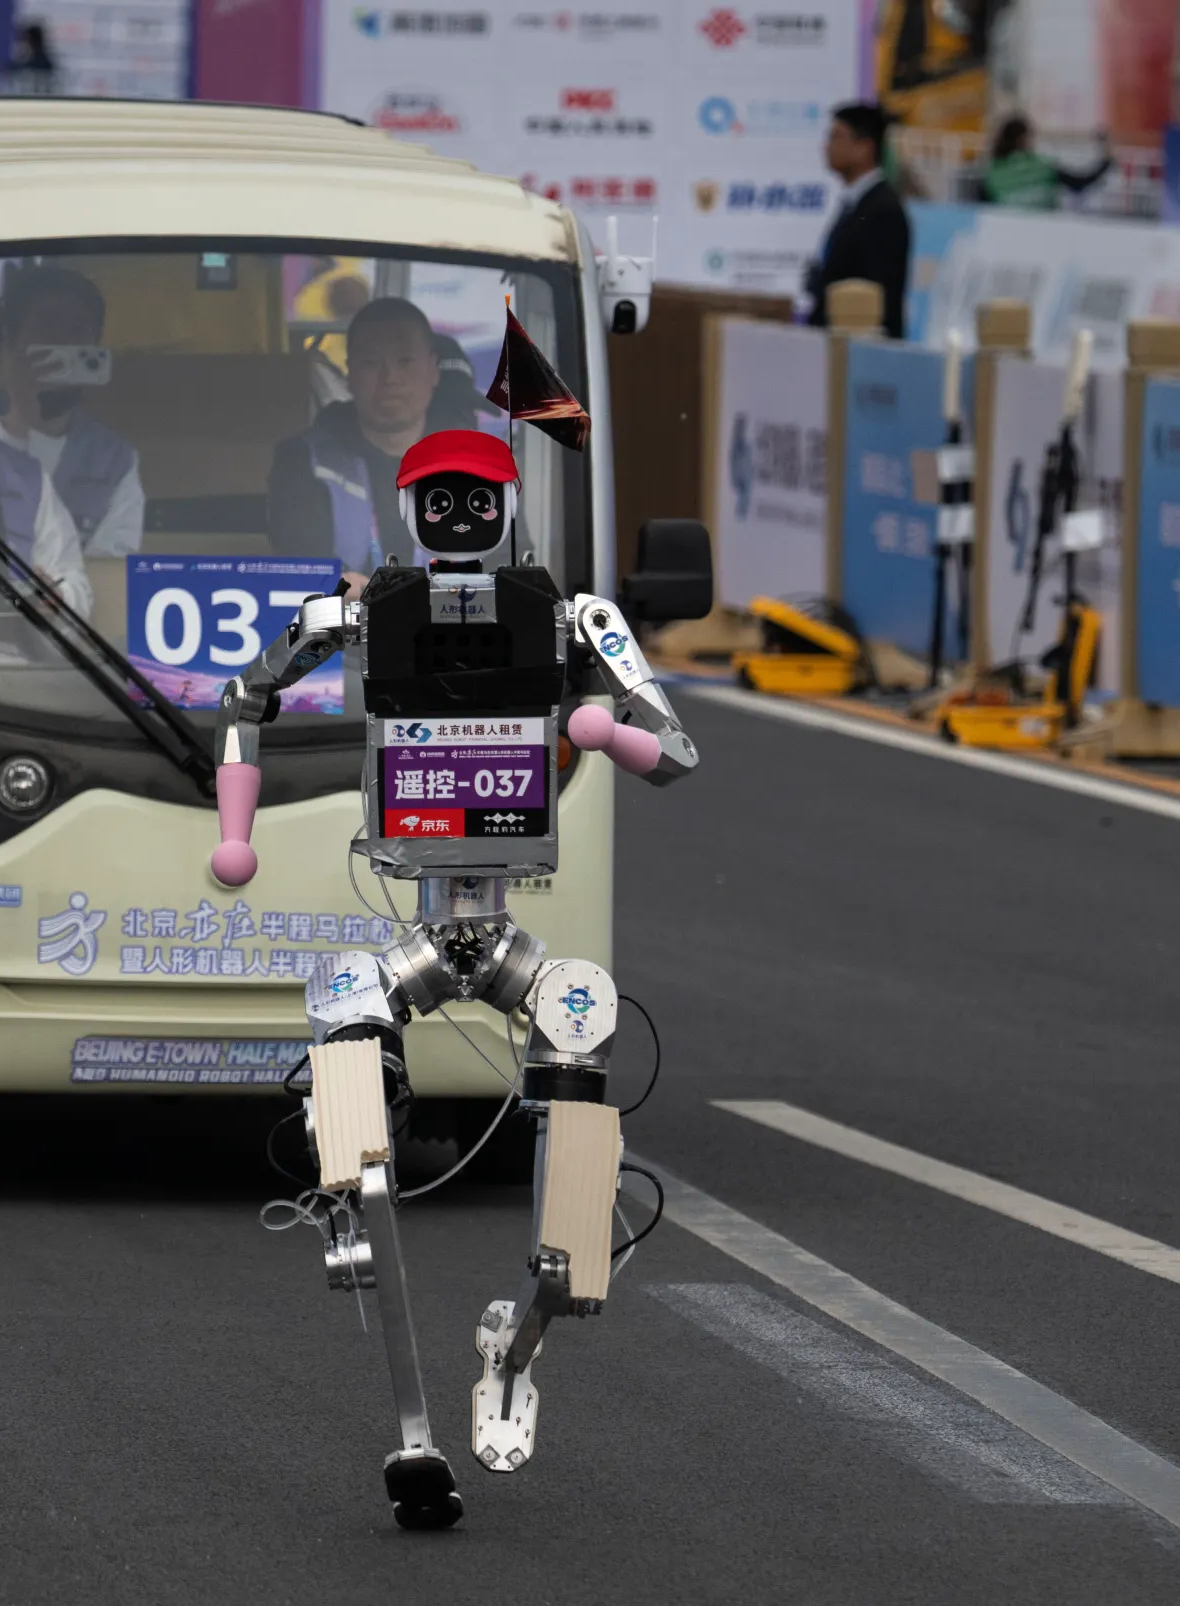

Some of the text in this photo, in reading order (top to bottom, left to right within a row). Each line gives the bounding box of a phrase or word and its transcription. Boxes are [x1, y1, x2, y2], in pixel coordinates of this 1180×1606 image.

[436, 723, 523, 736] 北京机器人租赁
[394, 769, 533, 799] 遥控-037
[421, 819, 450, 832] 京东
[561, 996, 597, 1006] ENCOS
[74, 1040, 146, 1063] BEIJING
[226, 1042, 277, 1066] HALF
[109, 1069, 196, 1083] HUMANOID
[199, 1070, 252, 1084] ROBOT
